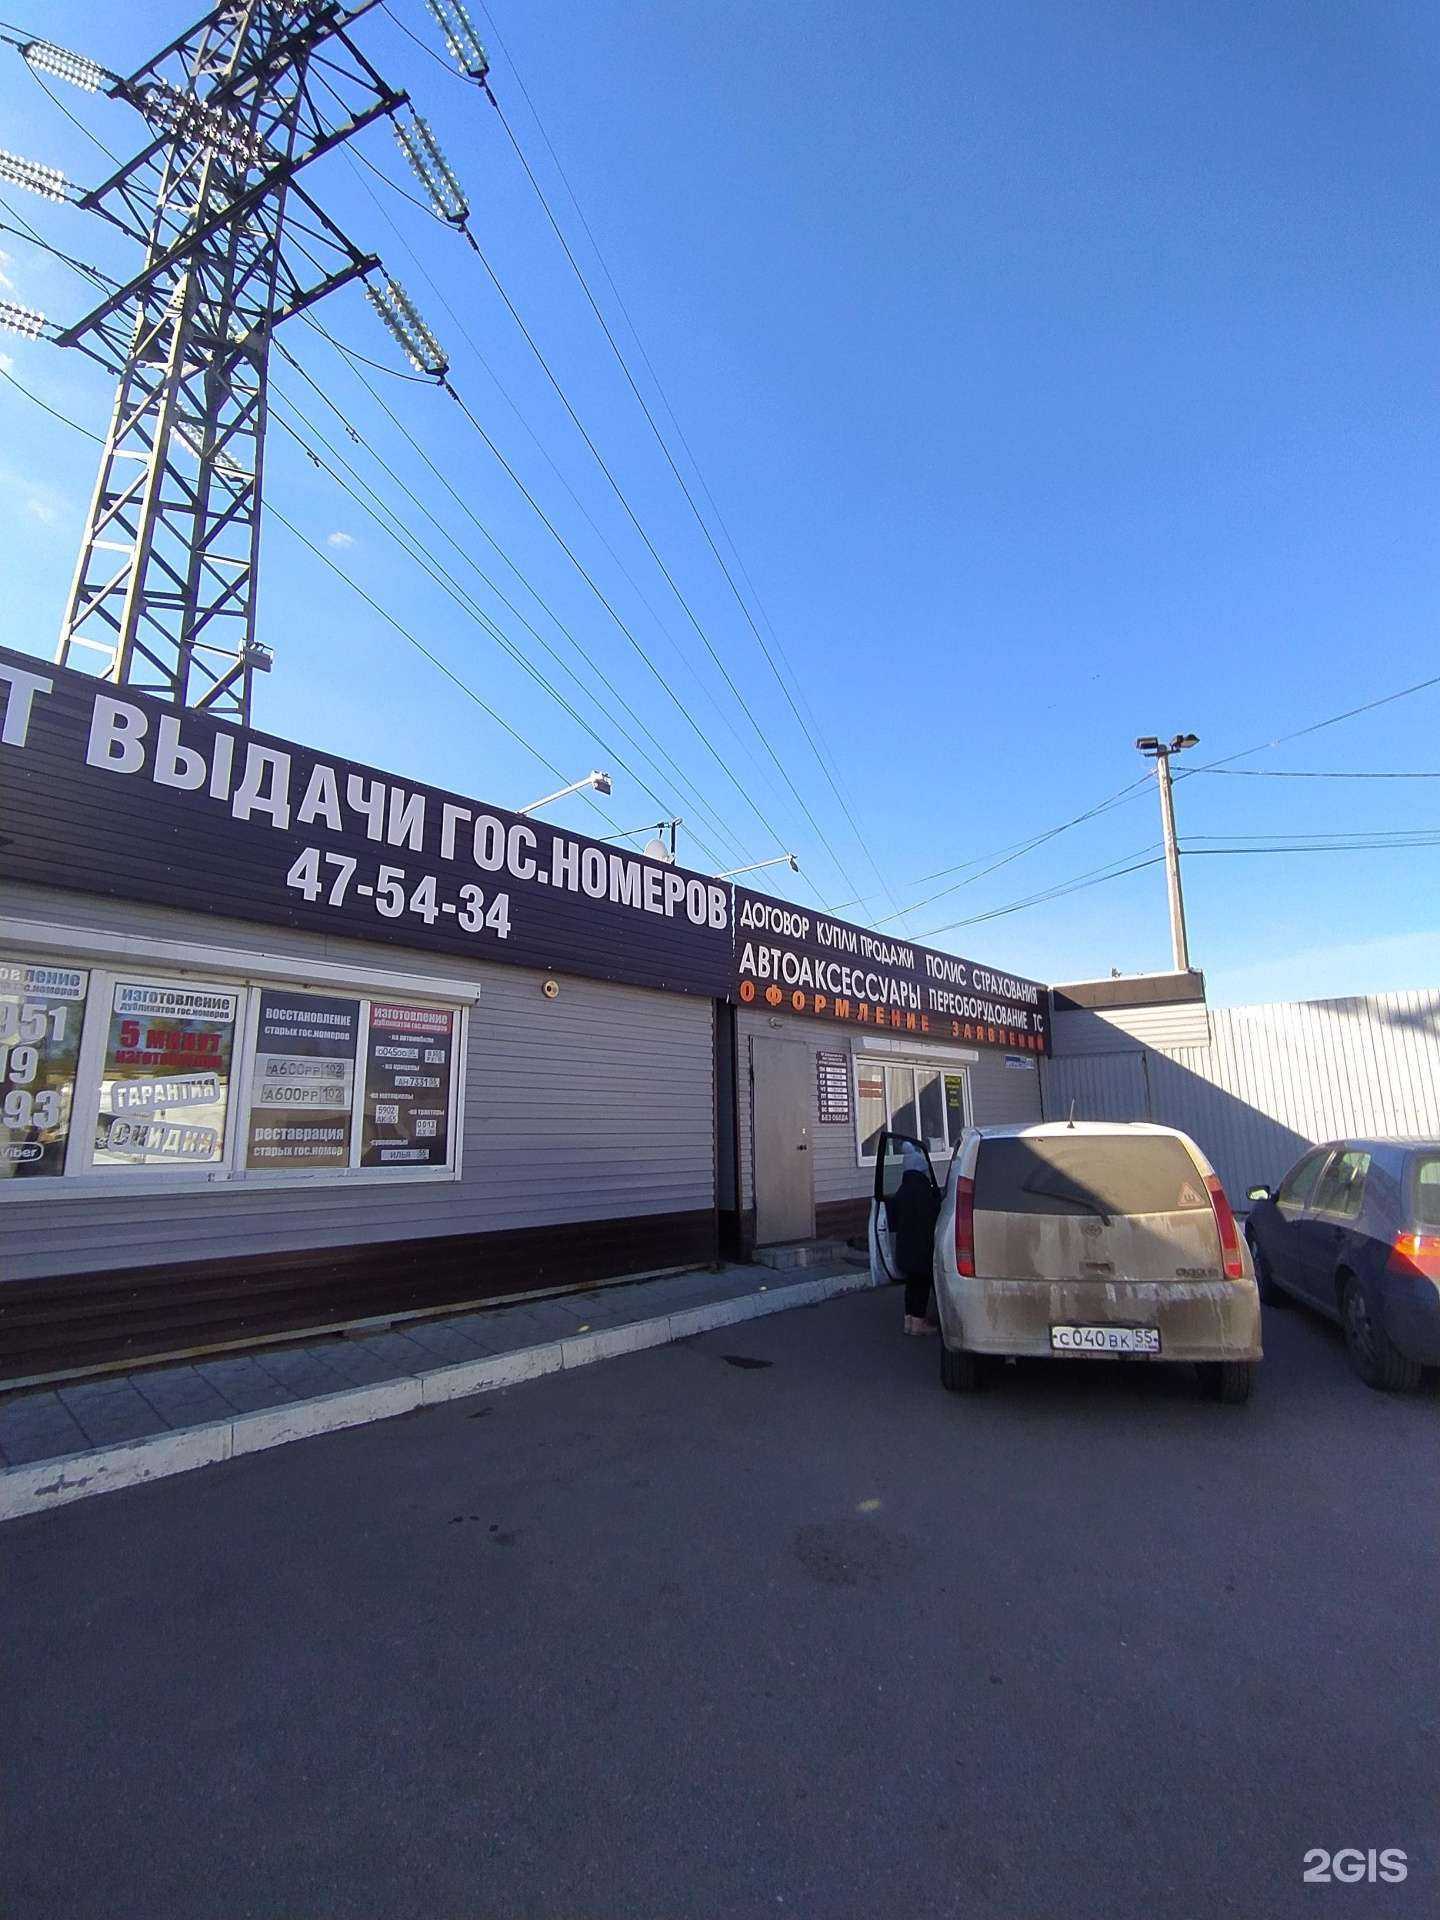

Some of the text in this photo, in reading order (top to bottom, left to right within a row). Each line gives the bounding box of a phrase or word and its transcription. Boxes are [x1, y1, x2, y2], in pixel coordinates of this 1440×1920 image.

[86, 694, 426, 852] ВЫДАЧИ
[441, 803, 728, 930] ГОС.НОМЕРОВ
[287, 847, 511, 939] 47-54-34
[740, 900, 914, 970] ДОГОВОР КУПЛИ ПРОДАЖИ
[739, 942, 921, 1010] АВТОАКСЕССУАРЫ
[926, 954, 1038, 1005] ПОЛИС СТРАХОВАНИЯ
[265, 1007, 352, 1026] ВОССТАНОВЛЕНИЕ
[740, 980, 929, 1033] ОФОРМЛЕНИЕ
[929, 988, 1044, 1033] ПЕРЕОБОРУДОВАНИЕ ТС
[120, 1020, 141, 1048] 5
[264, 1025, 350, 1041] старых гос.номеров
[253, 1146, 292, 1157] старых
[254, 1127, 344, 1142] реставрация
[1135, 1330, 1152, 1343] 55
